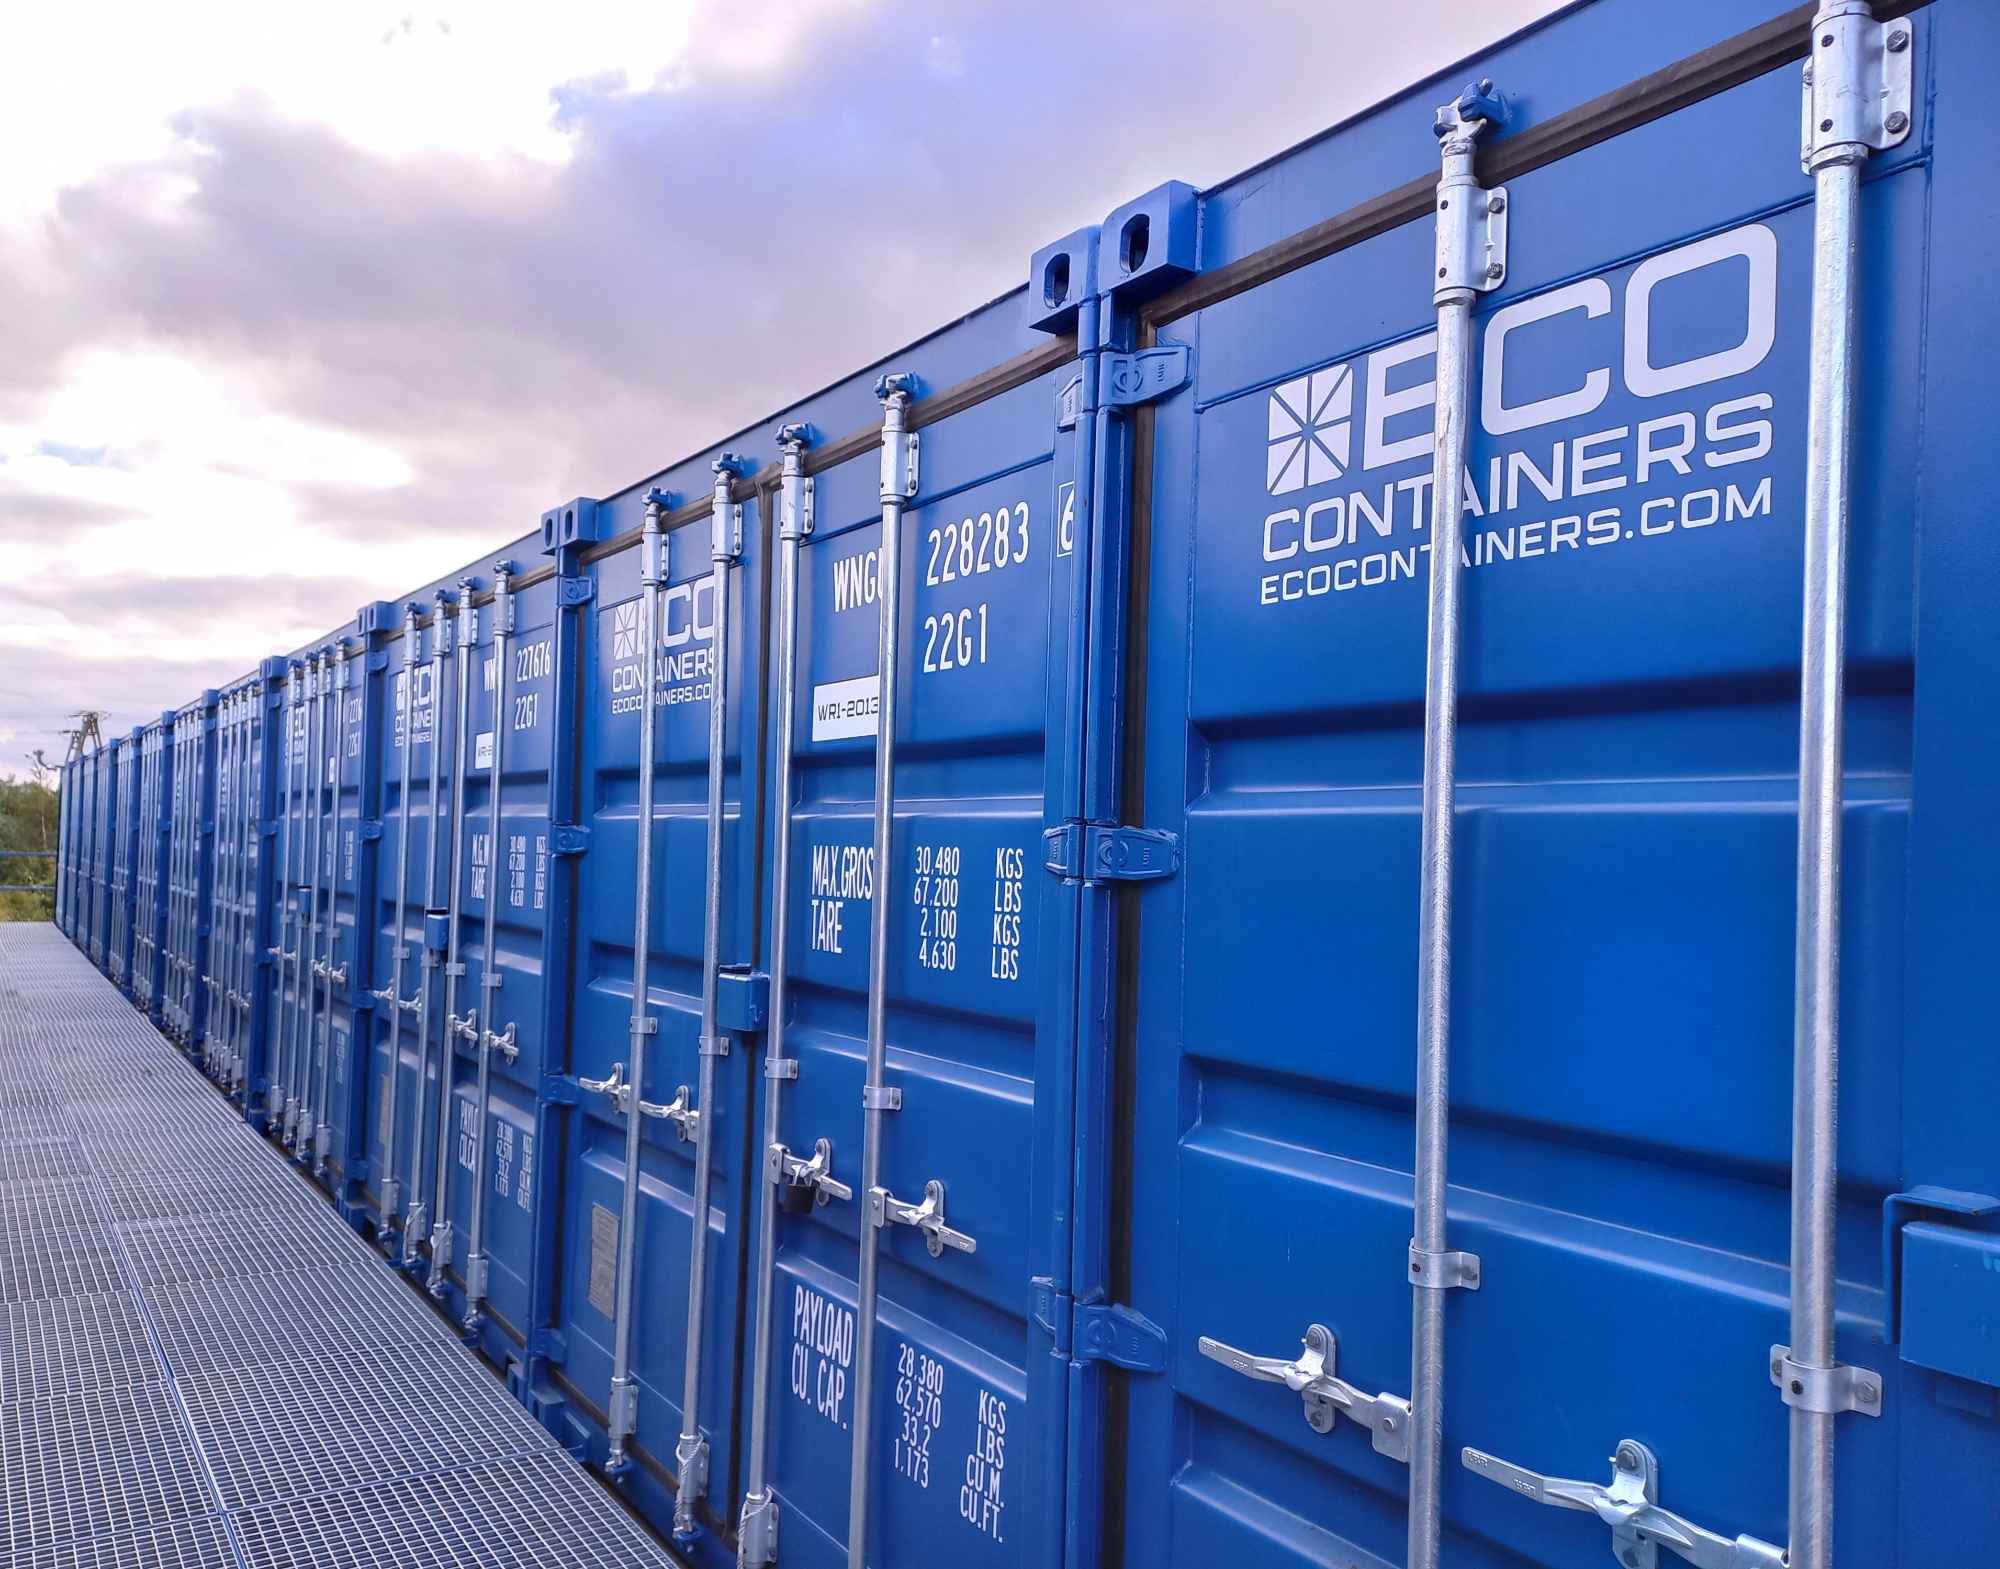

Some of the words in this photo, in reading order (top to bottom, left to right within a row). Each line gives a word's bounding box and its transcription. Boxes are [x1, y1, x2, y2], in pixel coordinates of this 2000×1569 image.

[1363, 223, 1777, 471] ECO
[1263, 392, 1774, 562] CONTAINERS
[926, 501, 1030, 587] 228283
[516, 641, 551, 682] 227676
[923, 603, 987, 673] 22G1
[612, 648, 714, 693] CONAINER
[612, 683, 712, 714] ECOCOAINERS.CO
[514, 693, 538, 730] 22G1
[811, 845, 874, 900] MAX.GROS
[915, 846, 960, 875] 30.480
[995, 848, 1024, 879] KGS
[914, 877, 959, 907] 67.200
[994, 880, 1022, 913] LBS
[811, 900, 844, 954] TARE
[920, 909, 957, 939] 2.100
[993, 914, 1021, 946] KGS
[919, 939, 956, 971] 4.630
[991, 947, 1019, 981] LBS
[794, 1285, 853, 1368] PAYLOAD
[792, 1342, 811, 1405] CU.
[817, 1359, 848, 1430] CAP.
[898, 1343, 944, 1395] 28.380
[978, 1389, 1006, 1434] KGS
[896, 1378, 942, 1428] 62.570
[976, 1424, 1005, 1469] LBS
[895, 1438, 929, 1488] 1.173
[960, 1485, 1003, 1543] CU.FT.
[902, 1411, 931, 1456] 33.2
[966, 1454, 1005, 1508] CU.M.
